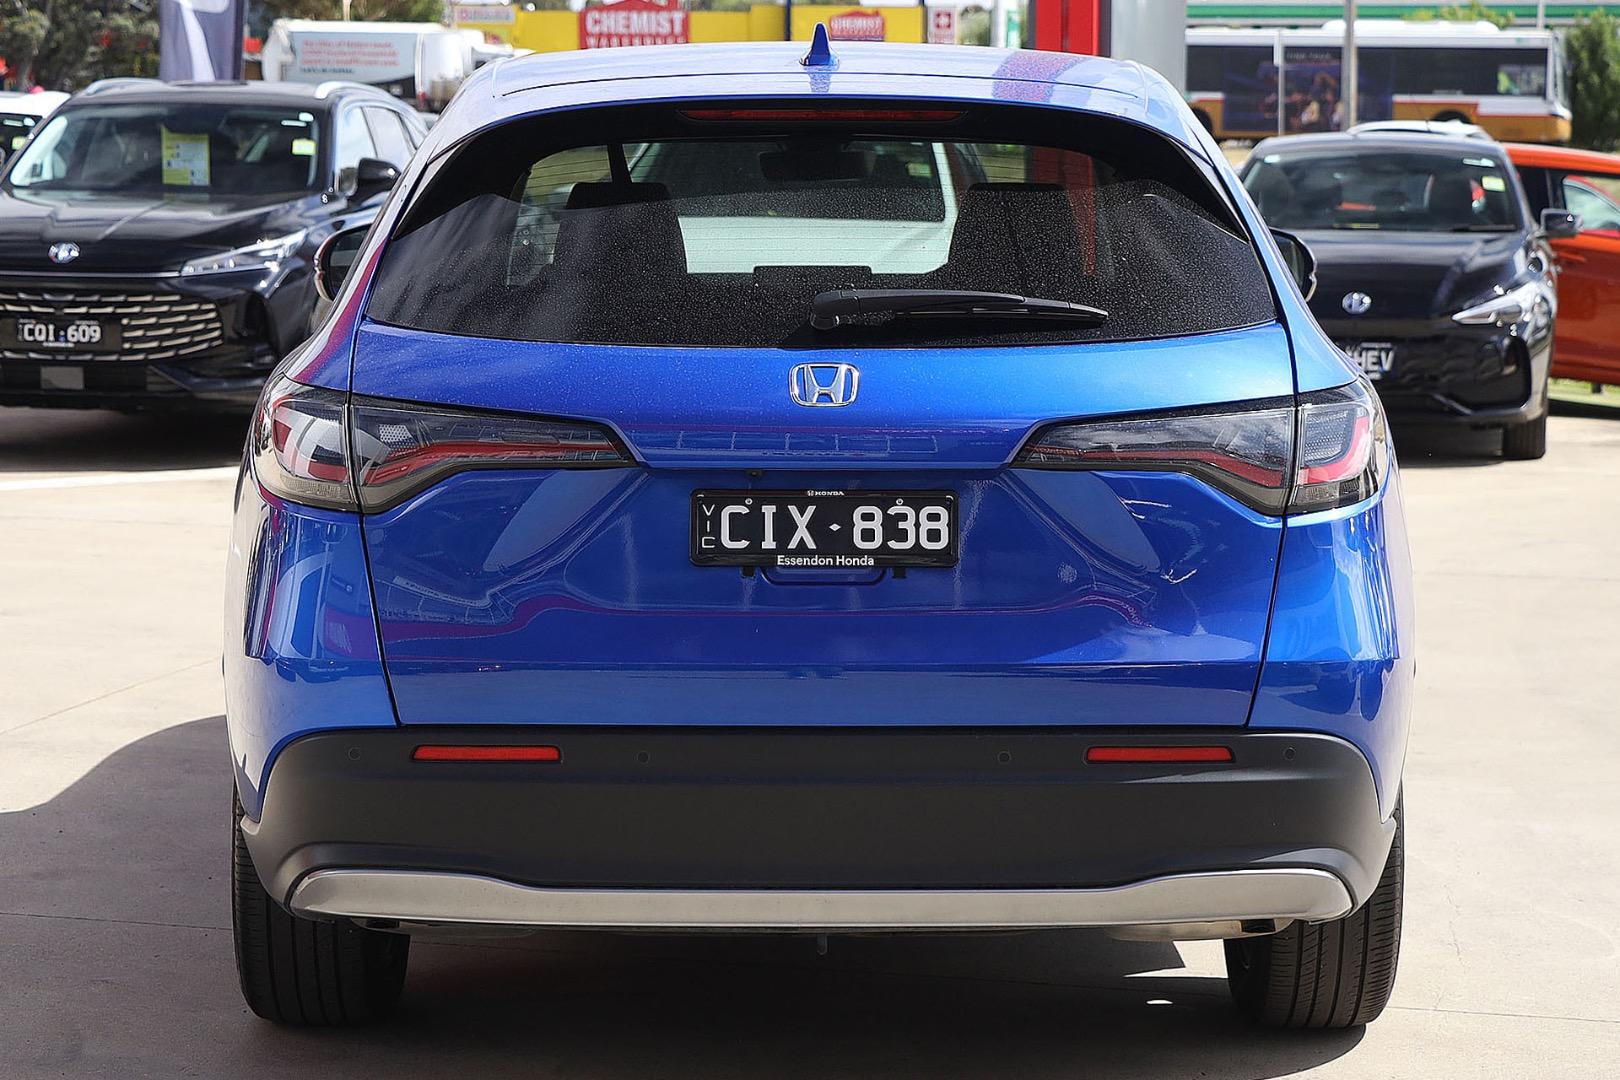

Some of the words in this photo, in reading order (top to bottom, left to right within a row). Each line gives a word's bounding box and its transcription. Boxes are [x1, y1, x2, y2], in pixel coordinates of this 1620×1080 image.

[585, 9, 685, 36] CHEMIST
[66, 324, 102, 342] 609
[701, 504, 716, 549] VIC
[720, 505, 817, 550] CIX
[853, 505, 949, 550] 838
[777, 555, 833, 566] Essendon
[836, 555, 875, 566] Honda
